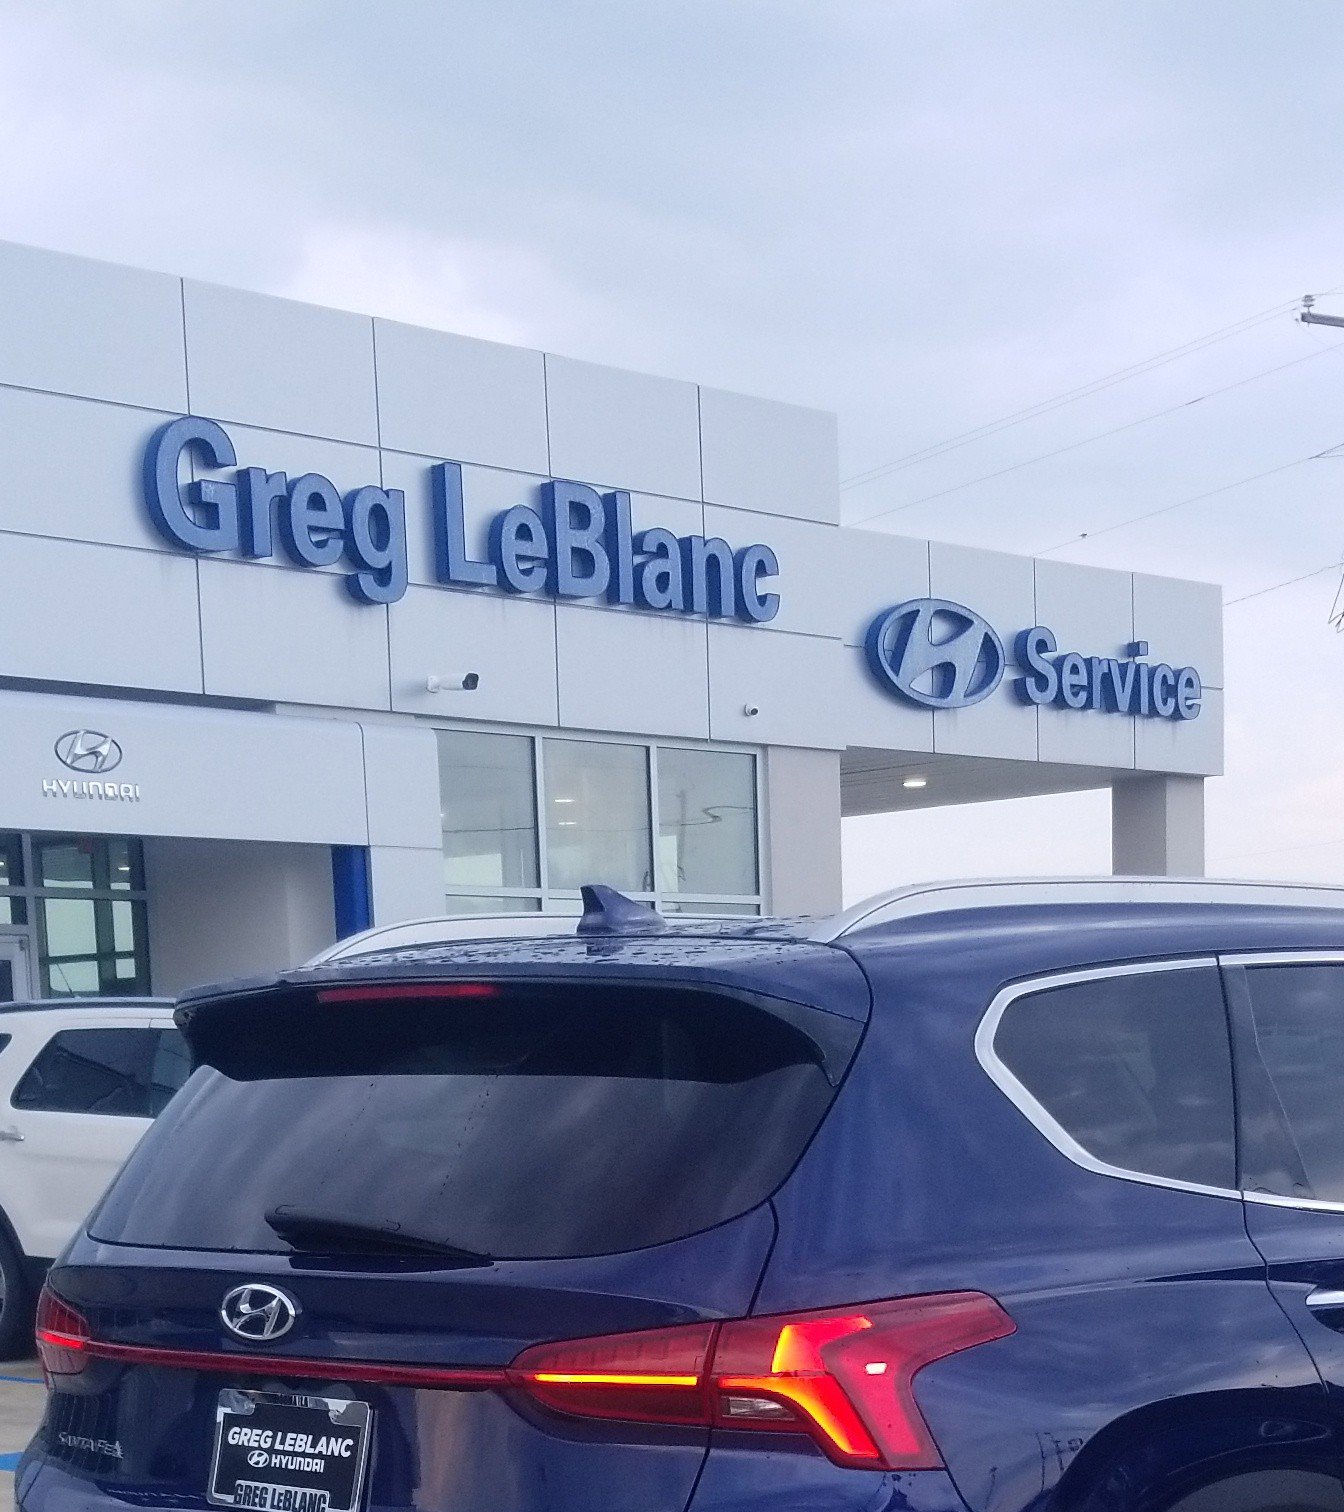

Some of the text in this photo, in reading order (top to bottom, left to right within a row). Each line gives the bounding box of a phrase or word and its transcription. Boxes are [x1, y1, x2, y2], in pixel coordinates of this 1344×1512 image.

[142, 416, 781, 623] Greg LeBlanc
[1012, 625, 1203, 720] Service
[42, 779, 141, 803] HYUNDAI
[228, 1426, 354, 1458] GREG LEBLANC
[271, 1454, 325, 1473] HYUNDAI
[233, 1483, 269, 1509] GREG
